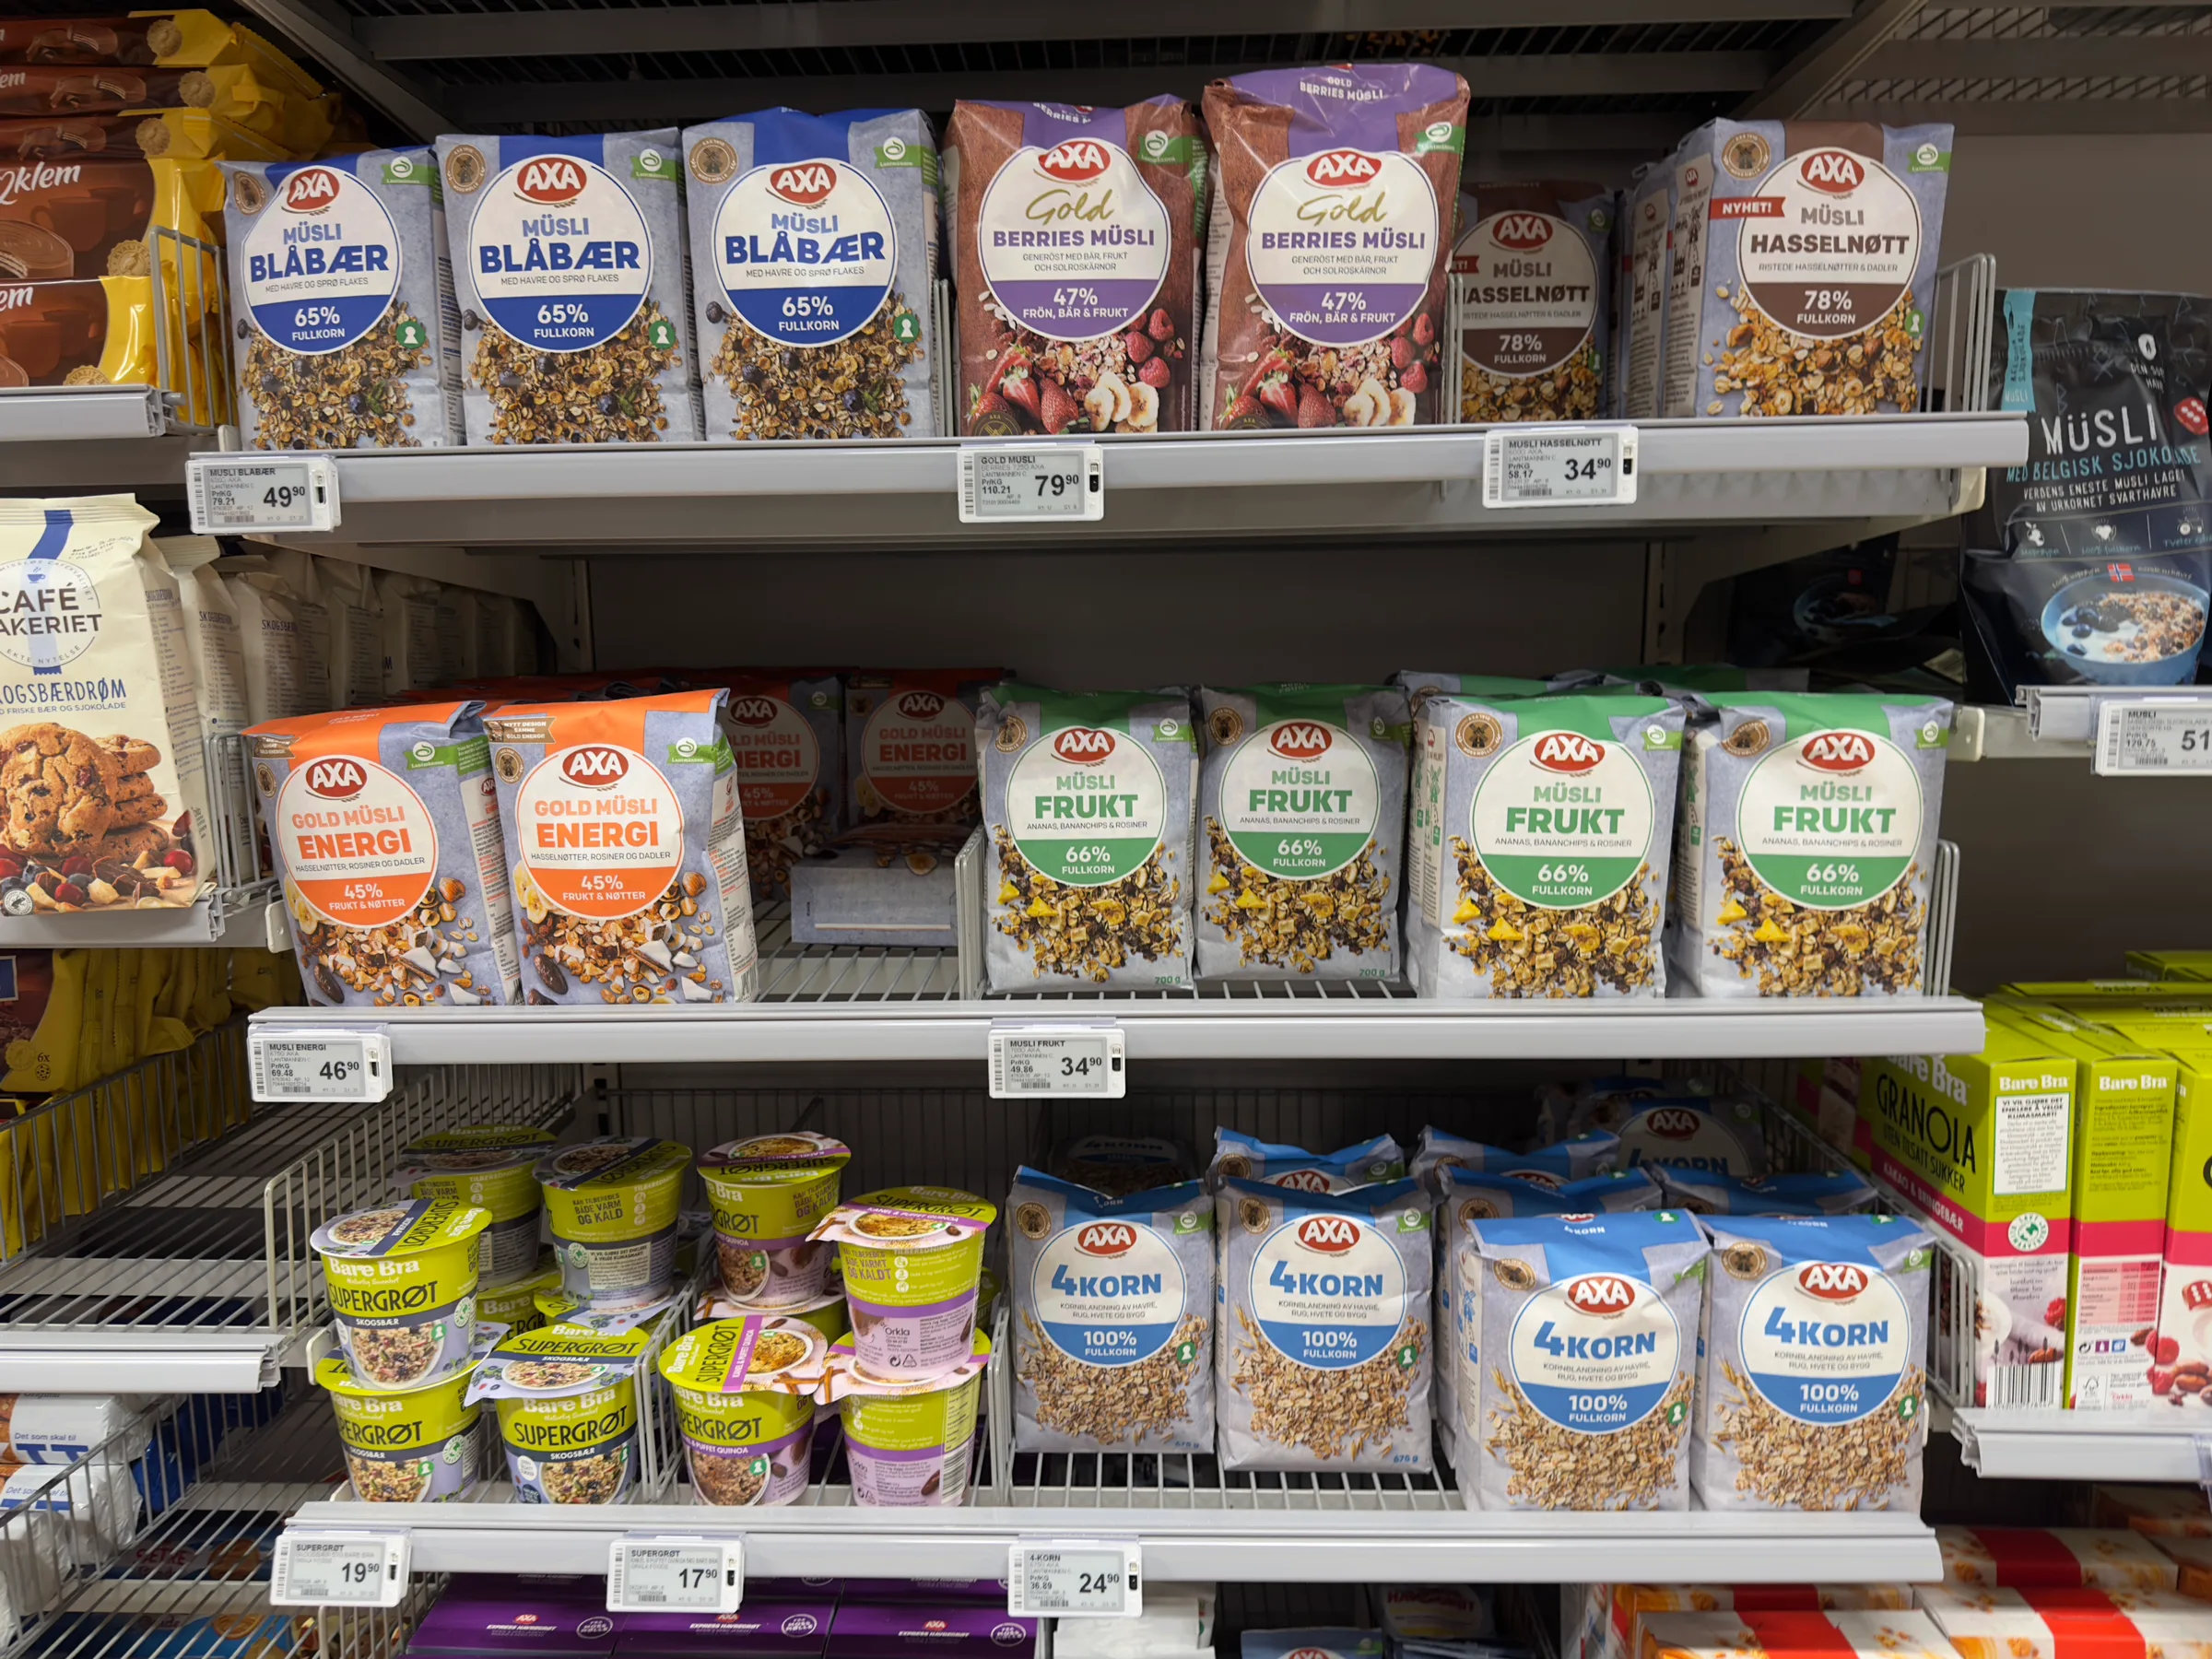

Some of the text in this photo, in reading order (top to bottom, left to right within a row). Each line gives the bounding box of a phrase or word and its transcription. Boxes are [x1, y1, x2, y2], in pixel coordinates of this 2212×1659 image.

[1045, 143, 1103, 169] AXA
[524, 163, 581, 191] AXA
[1807, 155, 1859, 184] AXA
[289, 172, 335, 202] AXA
[1026, 189, 1114, 225] Gold
[1297, 193, 1386, 226] Gold
[1723, 202, 1771, 215] NYHET!
[1801, 204, 1864, 226] MÜSLI
[283, 222, 341, 244] MÜSLI
[523, 218, 588, 237] MÜSLI
[771, 213, 838, 232] MÜSLI
[994, 225, 1154, 247] BERRIES MÜSLI
[1262, 228, 1425, 250] BERRIES MÜSLI
[1751, 235, 1909, 255] HASSELNØTT
[479, 236, 640, 273] BLÅBÆR
[725, 229, 886, 265] BLÅBÆR
[1023, 253, 1066, 261] GENERÖST
[1103, 252, 1127, 260] FRUKT
[250, 245, 389, 283] BLÅBÆR
[1053, 263, 1116, 271] SOLROSKÄRNOR
[1493, 259, 1551, 279] MÜSLI
[1759, 264, 1793, 272] RISTEDE
[1794, 263, 1858, 272] HASSELNØTTER
[1867, 264, 1898, 272] DADLER
[501, 274, 618, 286] MED HAVRE OG SPRØ FLAKES
[1053, 288, 1098, 306] 47%
[1805, 290, 1852, 310] 78%
[537, 304, 588, 324] 65%
[1023, 307, 1054, 319] FRÖN,
[1058, 307, 1080, 318] BÄR
[1094, 308, 1128, 317] FRUKT
[1796, 313, 1855, 324] FULLKORN
[535, 327, 594, 338] FULLKORN
[2041, 404, 2157, 454] MÜSLI
[2033, 456, 2102, 481] BELGISK
[2036, 485, 2176, 512] AV URKORNET SVARTHAVRE
[6, 645, 80, 664] EKTE NYTELSE
[75, 701, 126, 712] SJOKOLADE
[1059, 733, 1110, 754] AXA
[1808, 735, 1868, 761] AXA
[569, 751, 622, 777] AXA
[1056, 771, 1115, 790] MÜSLI
[1272, 767, 1330, 785] MÜSLI
[1249, 789, 1353, 813] FRUKT
[1534, 782, 1602, 804] MÜSLI
[1800, 782, 1872, 803] MÜSLI
[535, 795, 657, 816] GOLD MÜSLI
[1035, 794, 1138, 818] FRUKT
[291, 806, 406, 830] GOLD MÜSLI
[1060, 822, 1107, 830] BANANCHIPS
[1506, 807, 1624, 834] FRUKT
[1773, 807, 1896, 834] FRUKT
[297, 830, 411, 860] ENERGI
[537, 821, 658, 848] ENERGI
[591, 852, 624, 861] ROSINER
[639, 851, 670, 859] DADLER
[1065, 846, 1111, 863] 66%
[1062, 865, 1114, 875] FULLKORN
[581, 875, 623, 890] 45%
[562, 891, 594, 901] FRUKT
[606, 890, 646, 900] NØTTER
[1999, 1075, 2068, 1092] Bare Bra
[1877, 1073, 1976, 1174] GRANOLA
[1929, 1156, 1965, 1194] SUKKER
[1304, 1221, 1354, 1242] AXA
[329, 1256, 419, 1277] Bare Bra
[1052, 1265, 1161, 1297] 4KORN
[1270, 1261, 1382, 1297] 4KORN
[1806, 1265, 1862, 1290] AXA
[329, 1281, 438, 1312] SUPERGRØT
[356, 1317, 399, 1326] SKOGSBÆR
[886, 1327, 911, 1336] Orkla
[1764, 1306, 1888, 1347] 4KORN
[514, 1339, 639, 1356] SUPERGRØT
[1302, 1331, 1357, 1347] 100%
[1534, 1321, 1656, 1359] 4KORN
[1303, 1349, 1357, 1359] FULLKORN
[514, 1406, 628, 1445] SUPERGRØT
[50, 1432, 66, 1441] skal
[550, 1449, 595, 1460] SKOGSBÆR
